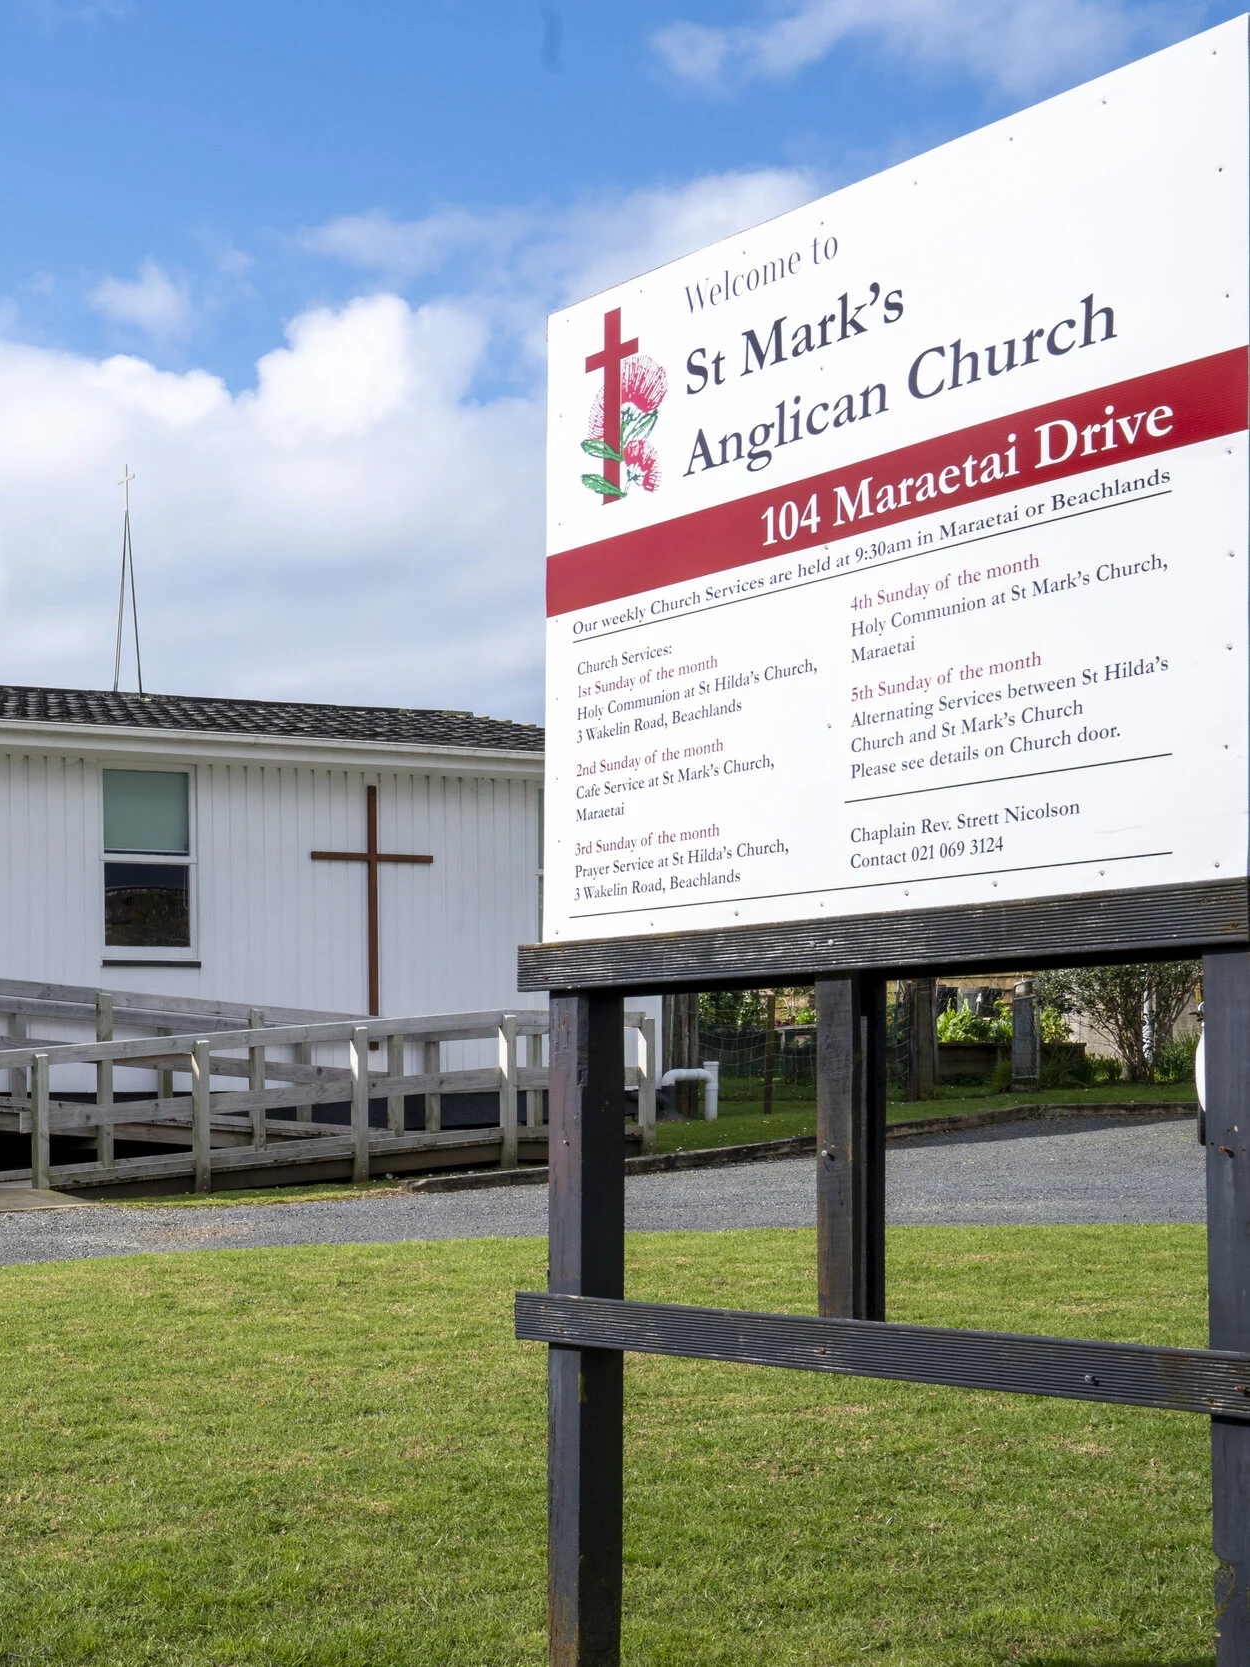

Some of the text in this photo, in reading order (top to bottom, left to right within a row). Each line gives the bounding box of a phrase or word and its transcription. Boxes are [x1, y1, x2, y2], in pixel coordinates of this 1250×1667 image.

[685, 235, 839, 314] Welcome to
[686, 282, 904, 395] St Mark's
[682, 293, 1118, 478] Anglican Church
[761, 405, 1173, 546] 104 Maraetai Drive
[573, 468, 1171, 635] Our weekly Church Services are held at 9:30am in Maraetai or Beachlands
[850, 553, 1040, 611] 4th Sunday of the month
[851, 553, 1168, 637] Holy Communion at St Mark's Church,
[577, 645, 672, 675] Church Services:
[851, 635, 915, 663] Maraetai
[577, 658, 817, 721] Holy Communion at St Hilda's Church,
[578, 655, 718, 698] 1st Sunday of the month
[851, 651, 1042, 702] 5th Sunday of the month
[851, 656, 1169, 728] Alternating Services between St Hilda's
[576, 699, 742, 744] 3 Wakelin Road, Beachlands
[851, 699, 1083, 753] Church and St Mark's Church
[576, 738, 723, 777] 2nd Sunday of the month
[576, 754, 774, 799] Cafe Service at St Mark's Church,
[850, 726, 1120, 779] Please see details on Church door.
[576, 802, 624, 822] Maraetai
[850, 802, 1080, 845] Chaplain Rev. Strett Nicolson
[575, 823, 720, 856] 3rd Sunday of the month
[575, 838, 789, 880] Prayer Service at St Hilda's Church,
[850, 836, 1004, 869] Contact 021 069 3124
[574, 869, 741, 901] 3 Wakelin Road, Beachlands
